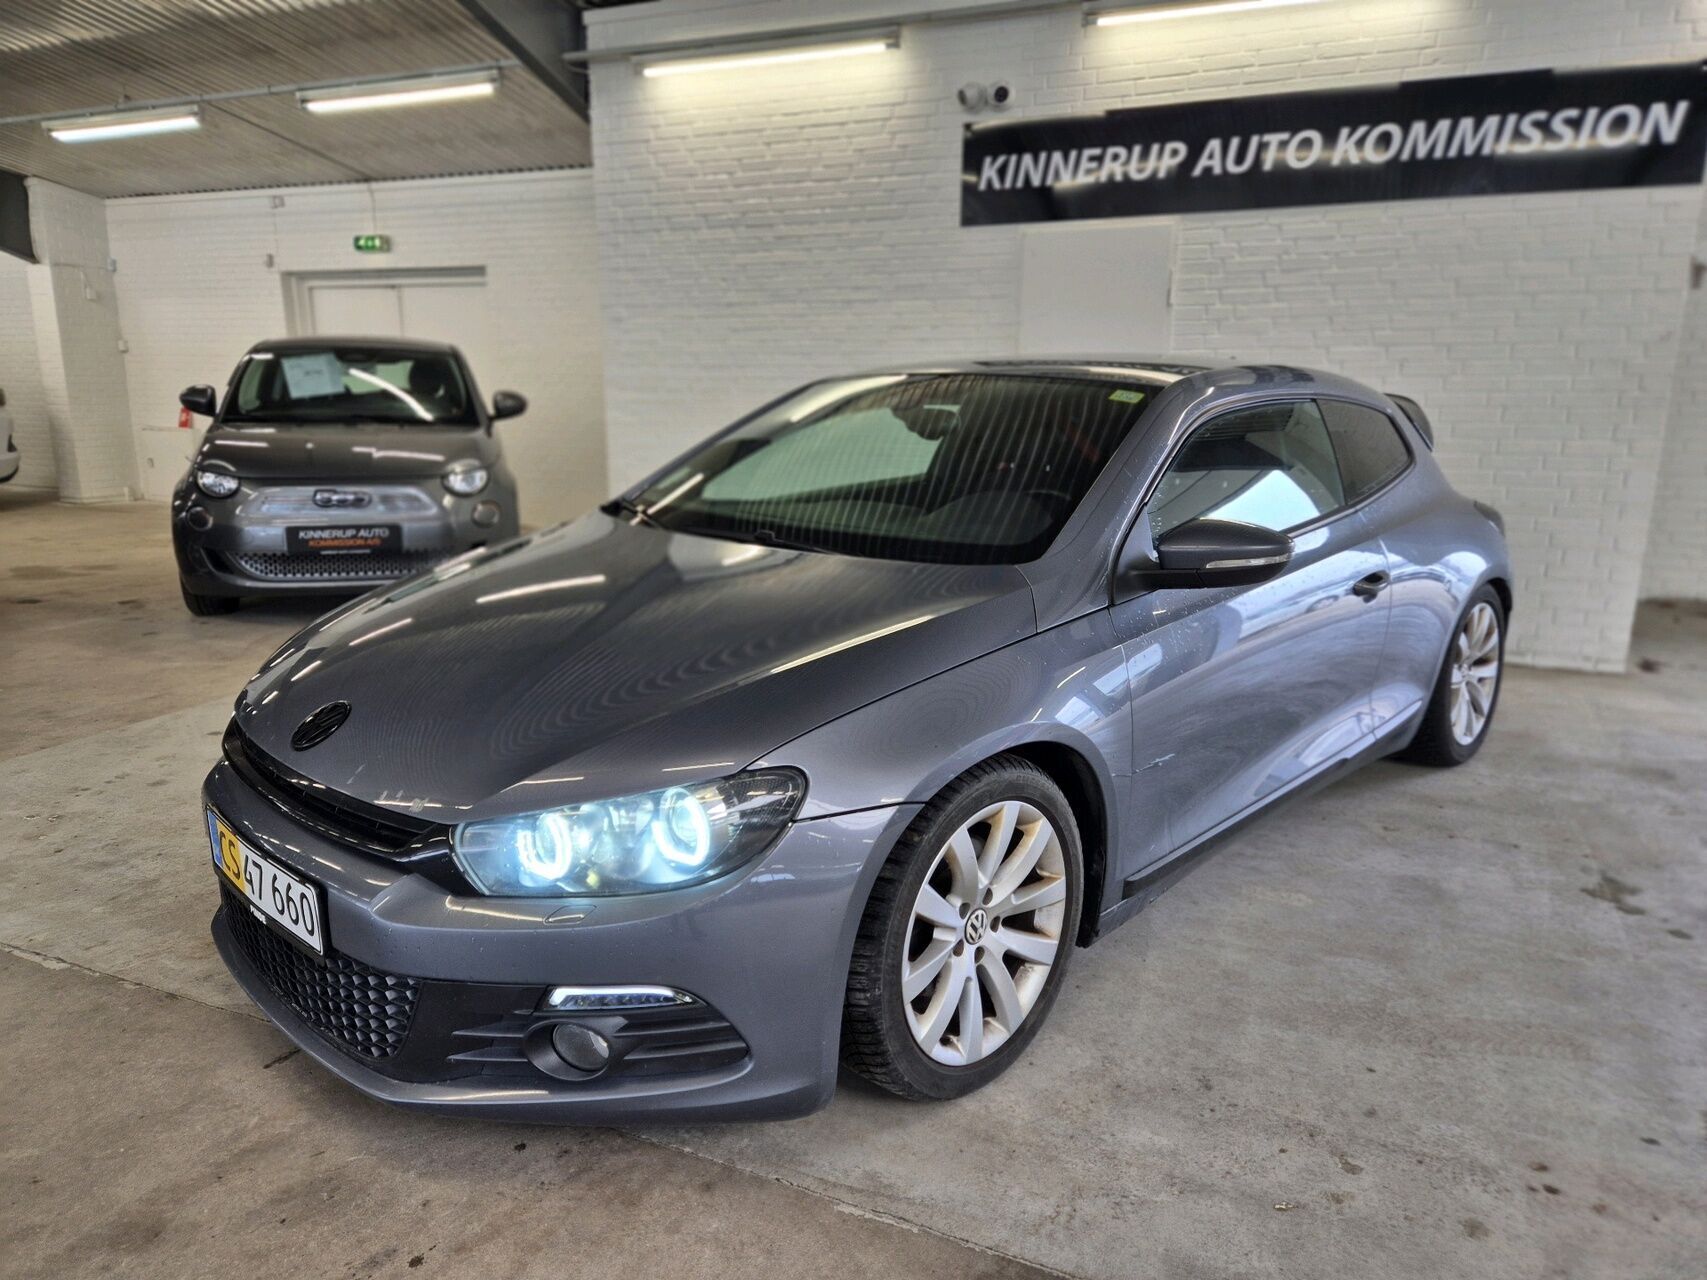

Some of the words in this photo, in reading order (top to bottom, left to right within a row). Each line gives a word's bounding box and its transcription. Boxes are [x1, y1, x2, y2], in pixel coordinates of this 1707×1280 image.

[978, 142, 1188, 192] KINNERUP
[1191, 129, 1324, 177] AUTO
[1331, 100, 1690, 167] KOMMISSION
[298, 529, 357, 540] KINNERUP
[358, 527, 390, 538] AUTO
[272, 873, 315, 937] 660
